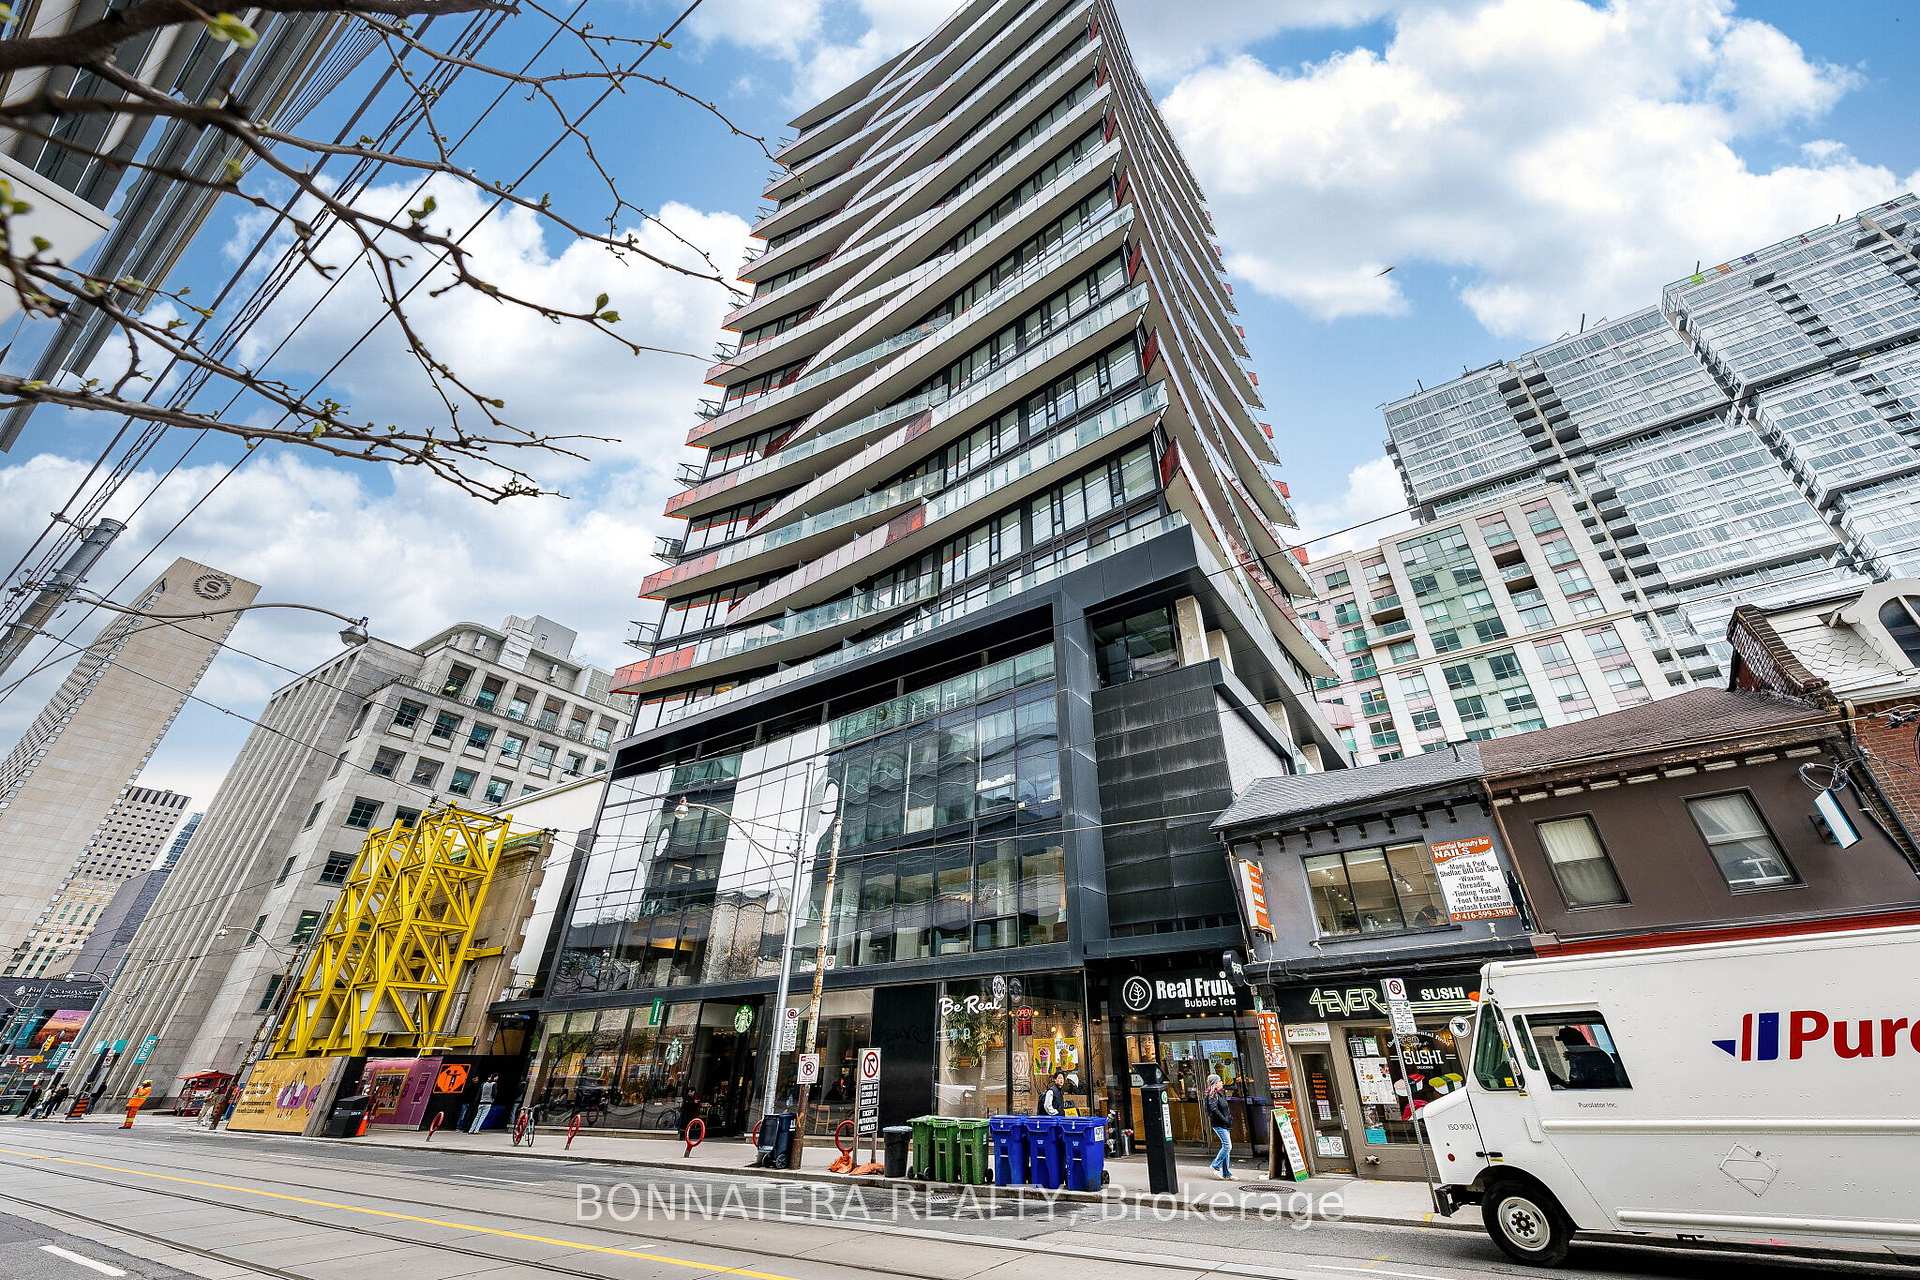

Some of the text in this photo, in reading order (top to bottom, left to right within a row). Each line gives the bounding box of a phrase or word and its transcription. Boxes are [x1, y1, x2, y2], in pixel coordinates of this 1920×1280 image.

[1431, 842, 1457, 851] Essential
[1458, 840, 1478, 849] Beauty
[1433, 847, 1470, 858] NAILS
[1487, 864, 1499, 872] Spa
[1473, 894, 1501, 903] Massage
[1479, 900, 1511, 909] Extension
[1155, 977, 1236, 999] Real Fruit
[939, 995, 1001, 1015] Be Real
[1185, 996, 1237, 1008] Bubble Tea
[1309, 987, 1387, 1017] 4EVER
[1421, 986, 1465, 1000] SUSHI
[1258, 1017, 1270, 1053] NAILS
[1267, 1017, 1281, 1053] NAILS
[1403, 1049, 1444, 1065] SUSHI
[1448, 1121, 1459, 1131] ISO
